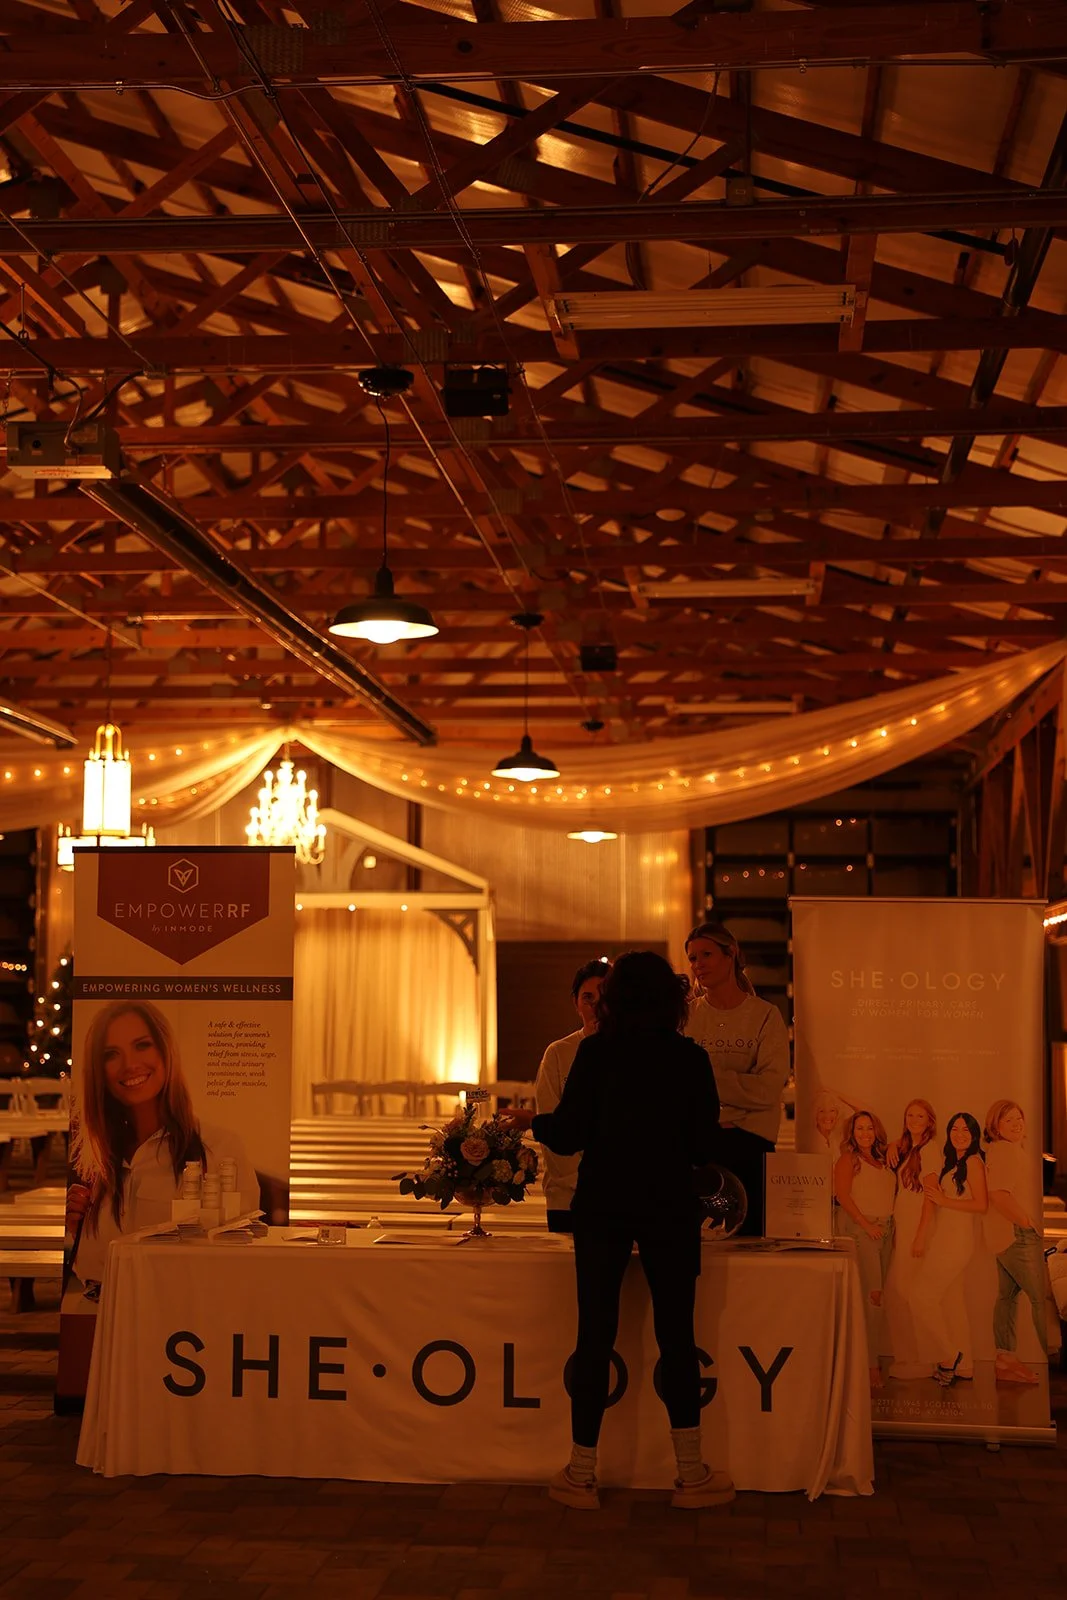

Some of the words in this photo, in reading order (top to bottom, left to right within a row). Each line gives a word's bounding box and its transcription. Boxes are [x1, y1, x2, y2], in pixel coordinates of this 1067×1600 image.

[114, 902, 251, 919] EMPOWERRF
[164, 924, 213, 933] INMODE
[82, 983, 160, 993] EMPOWERING
[164, 983, 219, 994] WOMEN'S
[222, 984, 281, 994] WELLNESS
[214, 1020, 227, 1029] safe
[236, 1020, 261, 1030] effective
[207, 1030, 233, 1038] solution
[232, 1030, 243, 1039] for
[236, 1040, 266, 1050] providing
[207, 1050, 223, 1058] relief
[223, 1050, 239, 1059] from
[770, 1175, 827, 1186] GIVEAWAY
